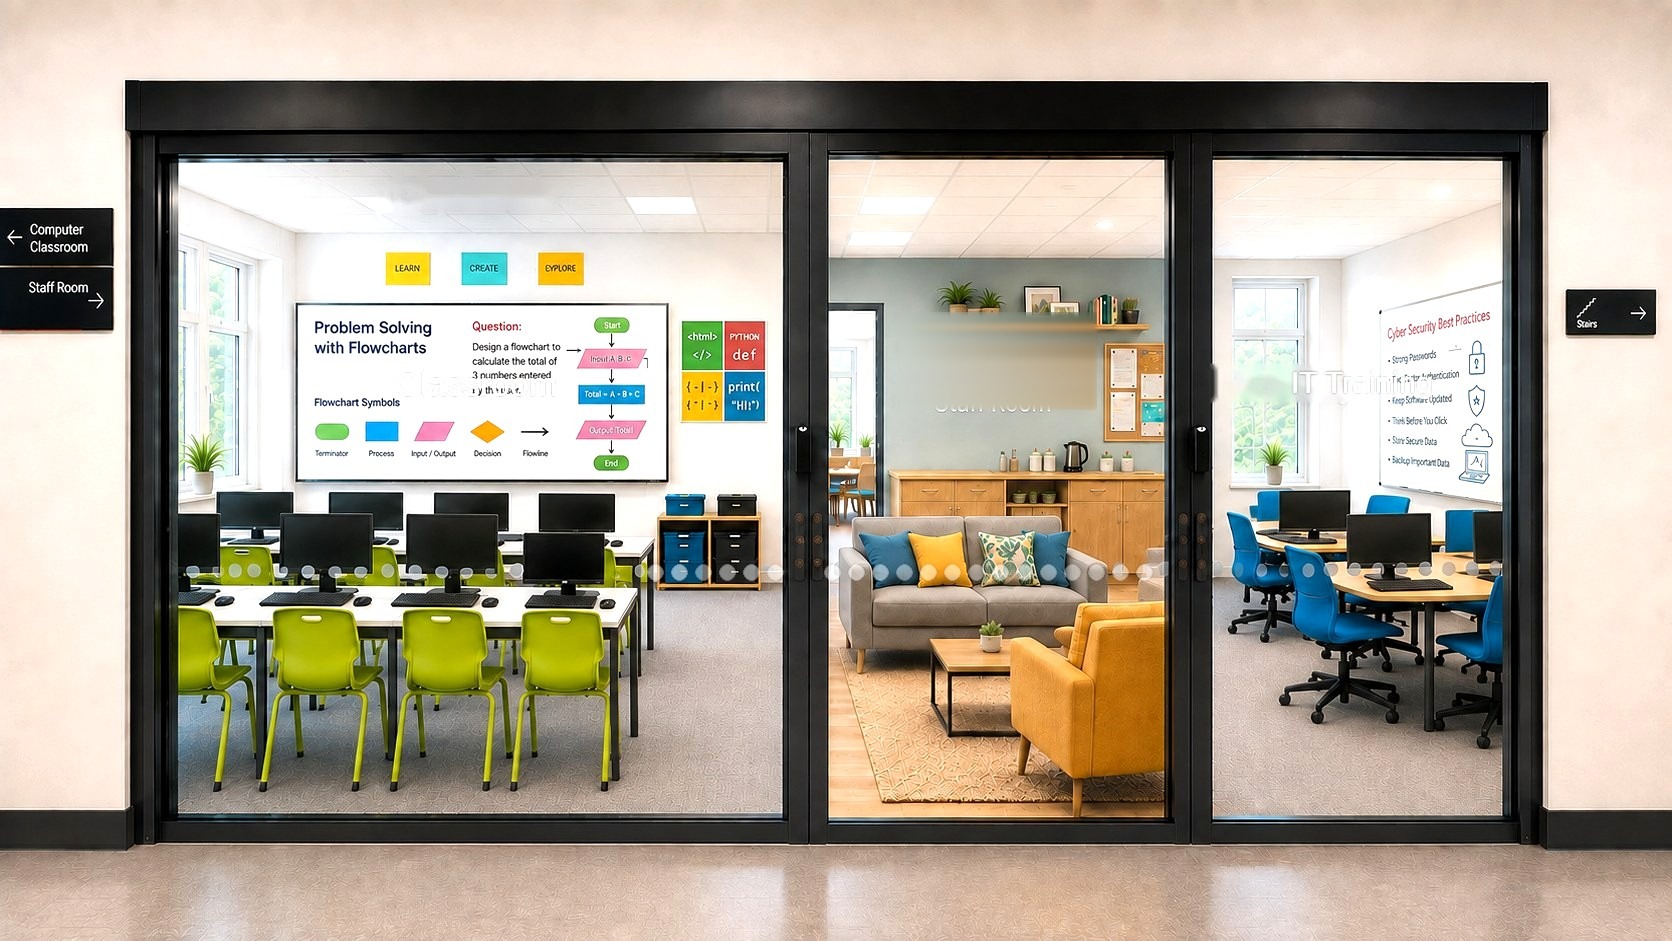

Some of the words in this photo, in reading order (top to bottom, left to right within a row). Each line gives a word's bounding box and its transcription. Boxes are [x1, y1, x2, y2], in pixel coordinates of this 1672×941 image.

[30, 223, 84, 238] Computer
[30, 240, 88, 253] Classroom
[395, 264, 421, 272] LEARN
[469, 264, 499, 272] CREATE
[28, 281, 55, 294] Staff
[57, 281, 89, 294] Room
[472, 321, 522, 332] Question:
[603, 321, 621, 329] Start
[1387, 327, 1407, 342] Cyber
[1408, 320, 1437, 335] Security
[1438, 317, 1454, 330] Best
[1455, 311, 1491, 326] Practices
[1576, 319, 1598, 329] Stairs
[314, 321, 374, 334] Problem
[379, 321, 432, 337] Solving
[687, 331, 717, 341] <html>
[729, 333, 760, 341] PYTHON
[314, 341, 344, 354] with
[349, 341, 427, 354] Flowcharts
[472, 343, 501, 353] Design
[511, 343, 550, 351] flowchart
[552, 343, 561, 351] to
[732, 348, 757, 361] def
[472, 357, 510, 366] calculate
[512, 357, 526, 366] the
[528, 357, 547, 366] total
[548, 357, 558, 366] of
[472, 371, 478, 379] 3
[480, 371, 518, 380] numbers
[519, 371, 552, 380] entered
[1292, 371, 1318, 394] IT
[728, 381, 760, 394] print(
[584, 390, 602, 398] Total
[610, 390, 616, 398] A
[622, 390, 628, 398] B
[634, 390, 640, 398] C
[314, 398, 359, 407] Flowchart
[361, 398, 401, 409] Symbols
[1423, 416, 1434, 425] You
[1424, 437, 1438, 446] Data
[315, 449, 349, 457] Terminator
[368, 449, 395, 457] Process
[411, 450, 428, 458] Input
[434, 450, 456, 458] Output
[473, 449, 502, 457] Decision
[523, 449, 549, 457] Flowline
[604, 459, 619, 467] End
[1437, 458, 1451, 468] Data
